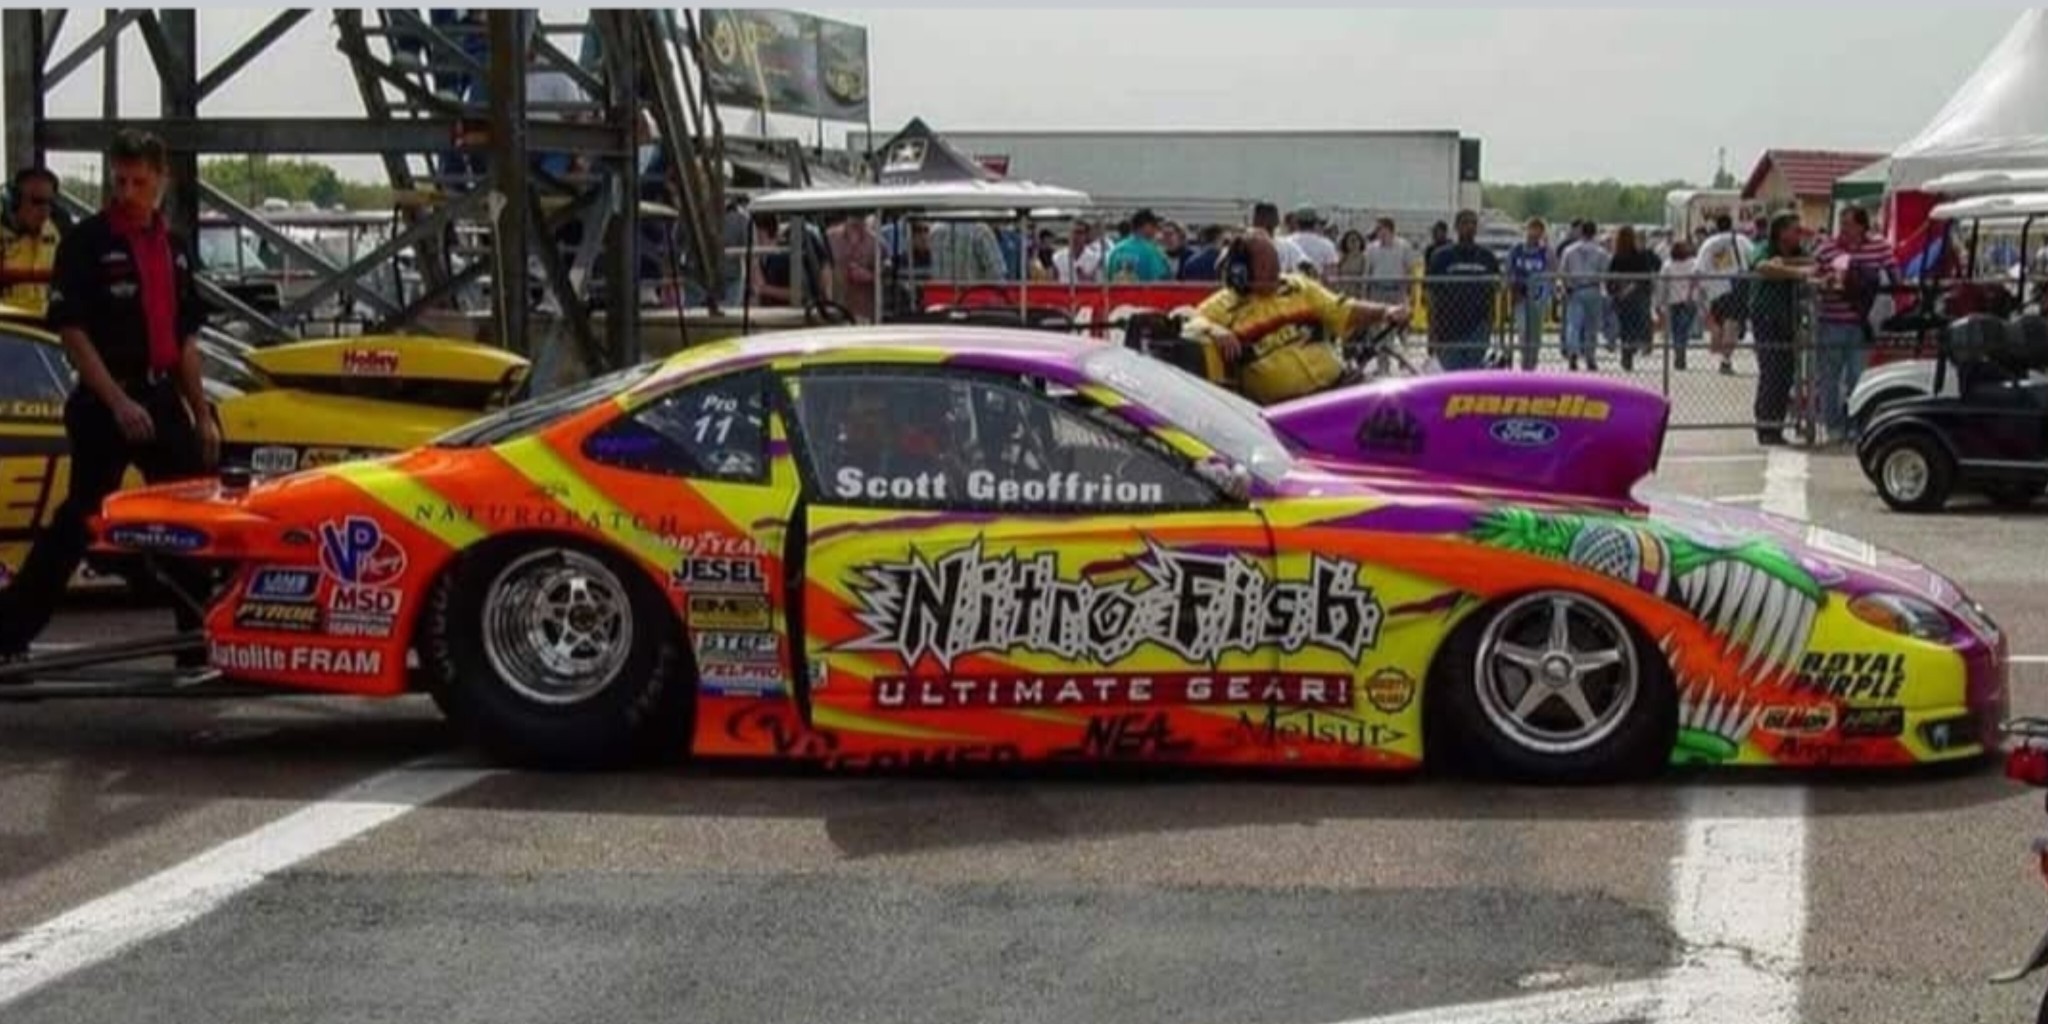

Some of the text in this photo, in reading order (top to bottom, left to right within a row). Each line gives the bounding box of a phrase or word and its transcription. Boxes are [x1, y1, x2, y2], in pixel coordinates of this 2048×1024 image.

[702, 395, 738, 411] Pro
[1444, 394, 1611, 421] panella
[694, 416, 733, 443] 11
[836, 467, 1163, 502] Scott Geoffrion
[321, 517, 382, 590] VP
[673, 558, 764, 583] JESEL
[332, 588, 398, 614] MSD
[842, 536, 1382, 672] Nitro Fish
[290, 647, 381, 674] FRAM
[1801, 652, 1906, 673] ROYAL
[878, 677, 1154, 704] ULTIMATE
[1186, 677, 1349, 704] GEAR!
